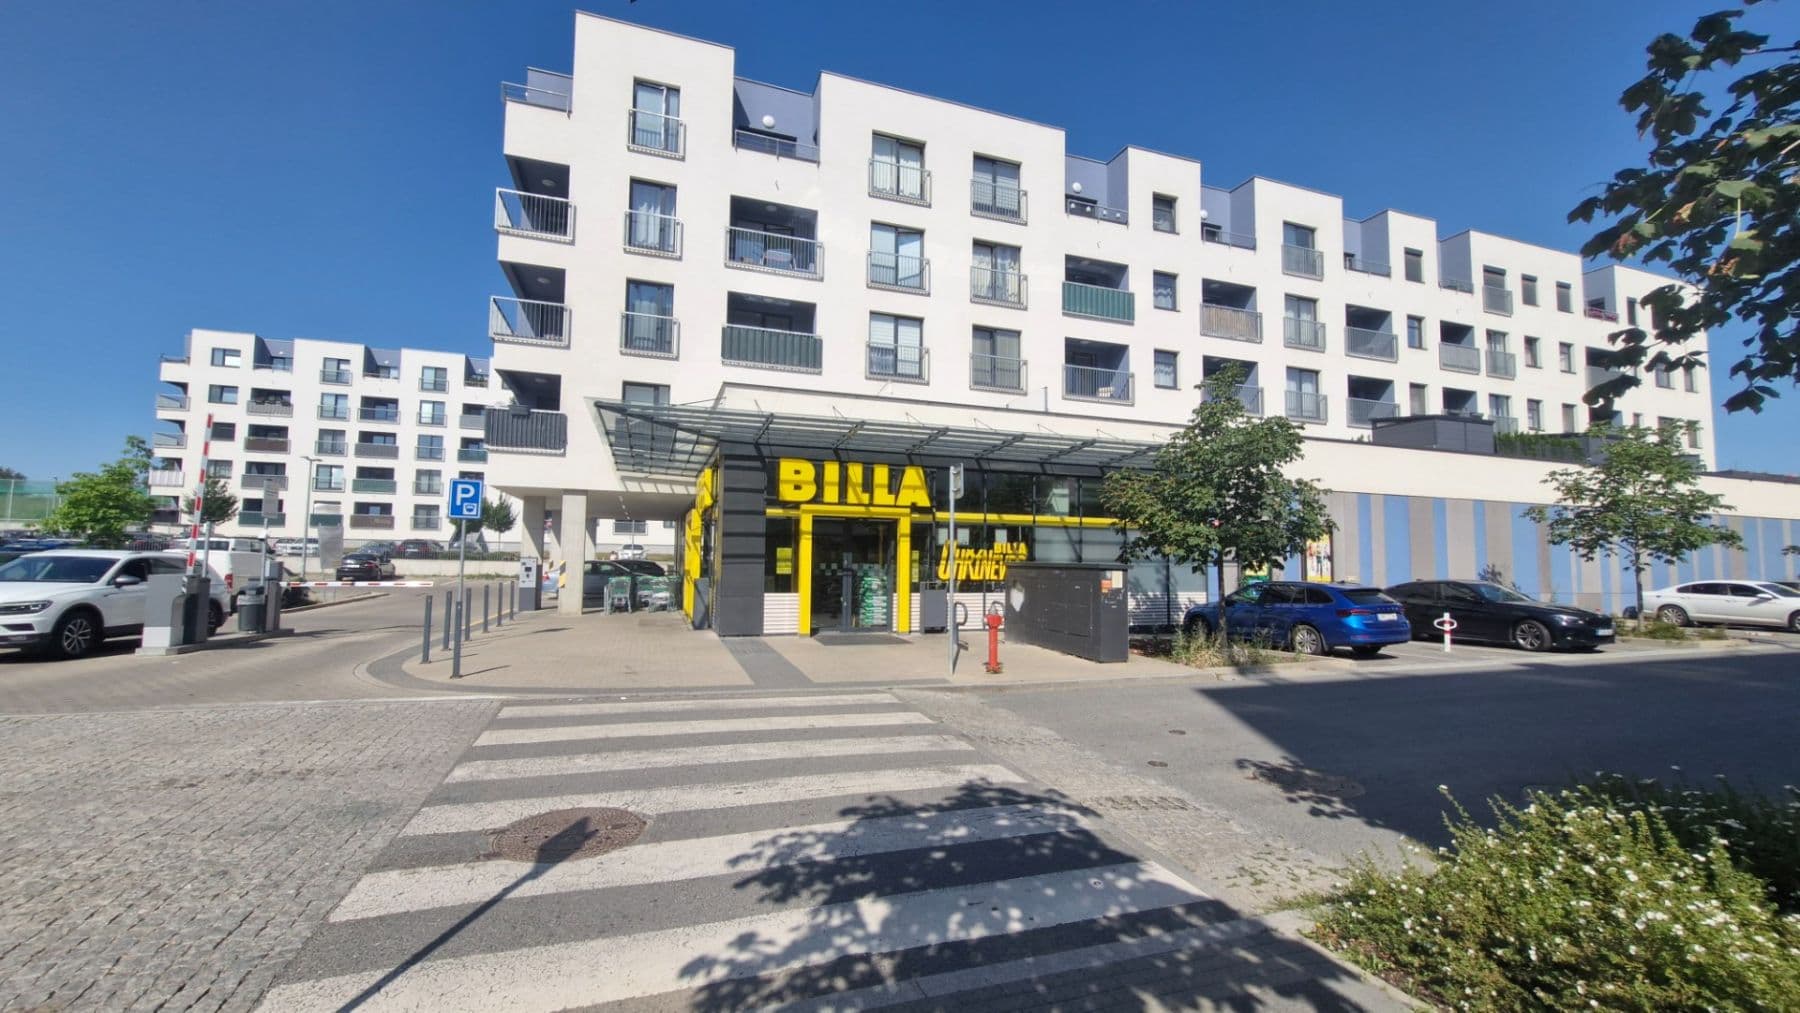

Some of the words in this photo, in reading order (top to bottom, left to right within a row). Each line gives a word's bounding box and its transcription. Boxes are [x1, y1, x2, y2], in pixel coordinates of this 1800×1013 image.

[778, 457, 931, 507] BILLA
[456, 484, 475, 506] P
[993, 541, 1028, 554] BILLA
